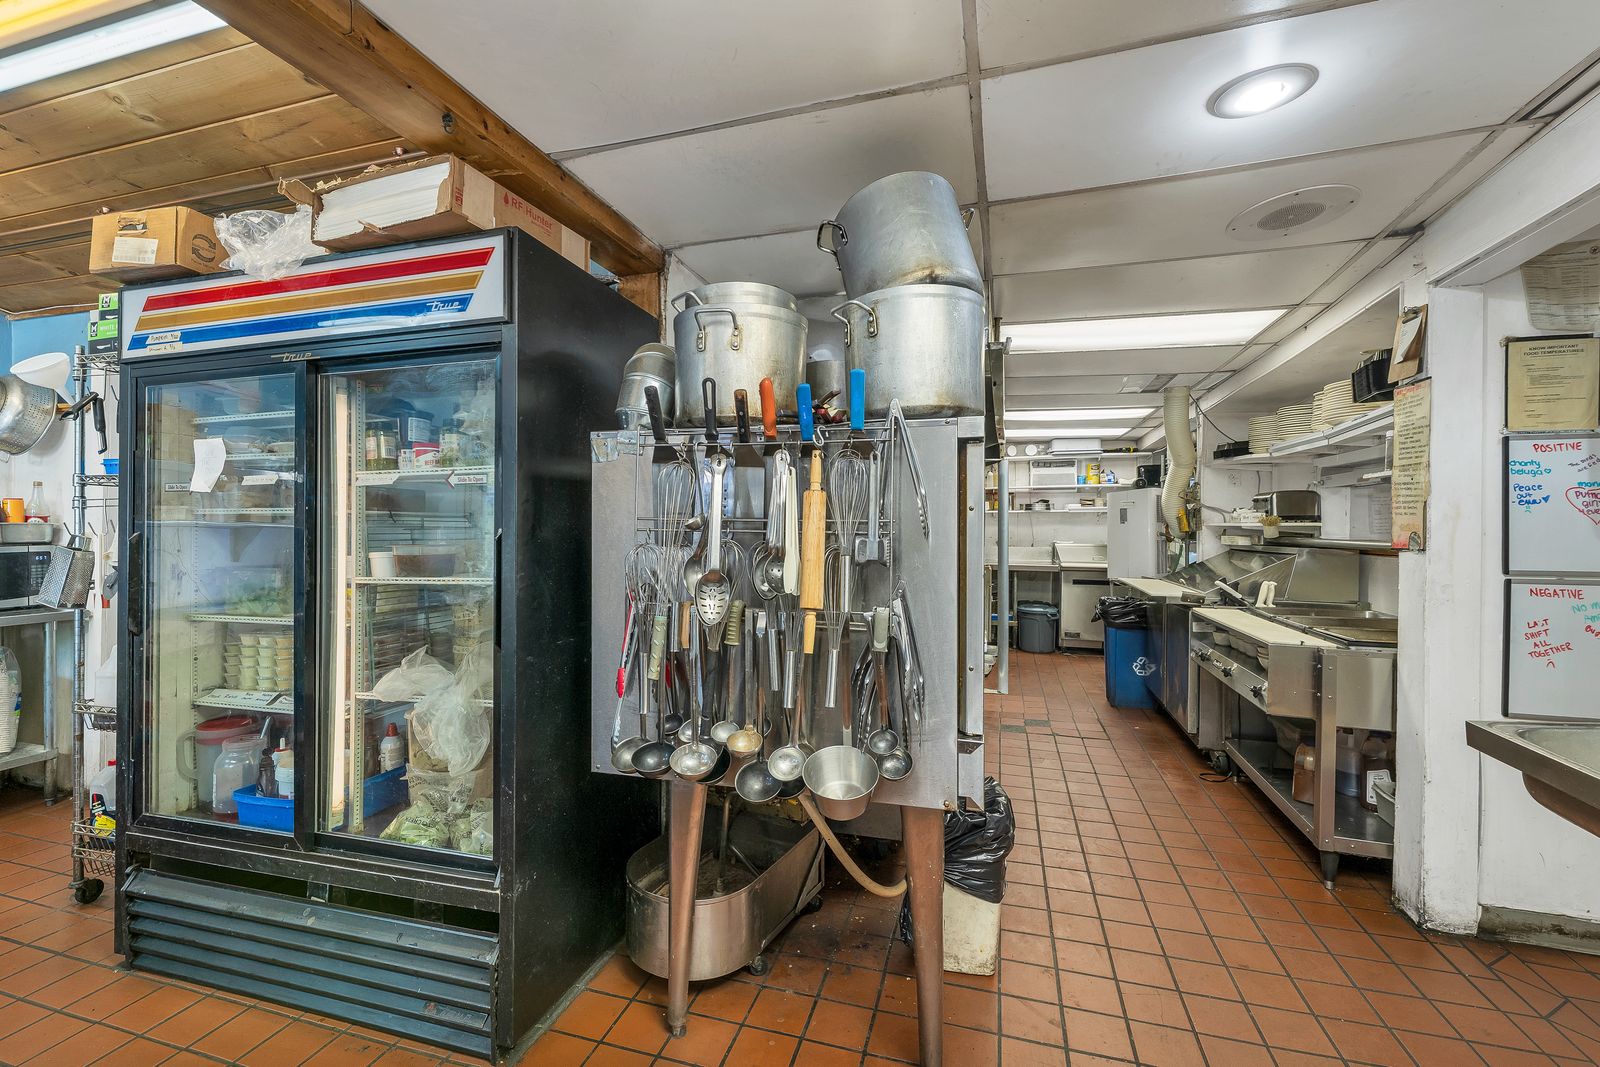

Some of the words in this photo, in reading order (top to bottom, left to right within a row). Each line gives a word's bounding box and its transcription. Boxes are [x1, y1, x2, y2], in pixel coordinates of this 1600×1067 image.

[511, 197, 524, 211] RF
[525, 207, 553, 229] Hunter
[1533, 442, 1582, 453] POSITIVE
[1511, 468, 1543, 477] beluga
[1513, 483, 1542, 492] Peace
[1529, 587, 1584, 600] NEGATIVE
[1572, 603, 1587, 614] NO
[1524, 628, 1549, 640] SHIFT
[1528, 642, 1573, 658] TOGETHER
[1533, 640, 1551, 649] ALL
